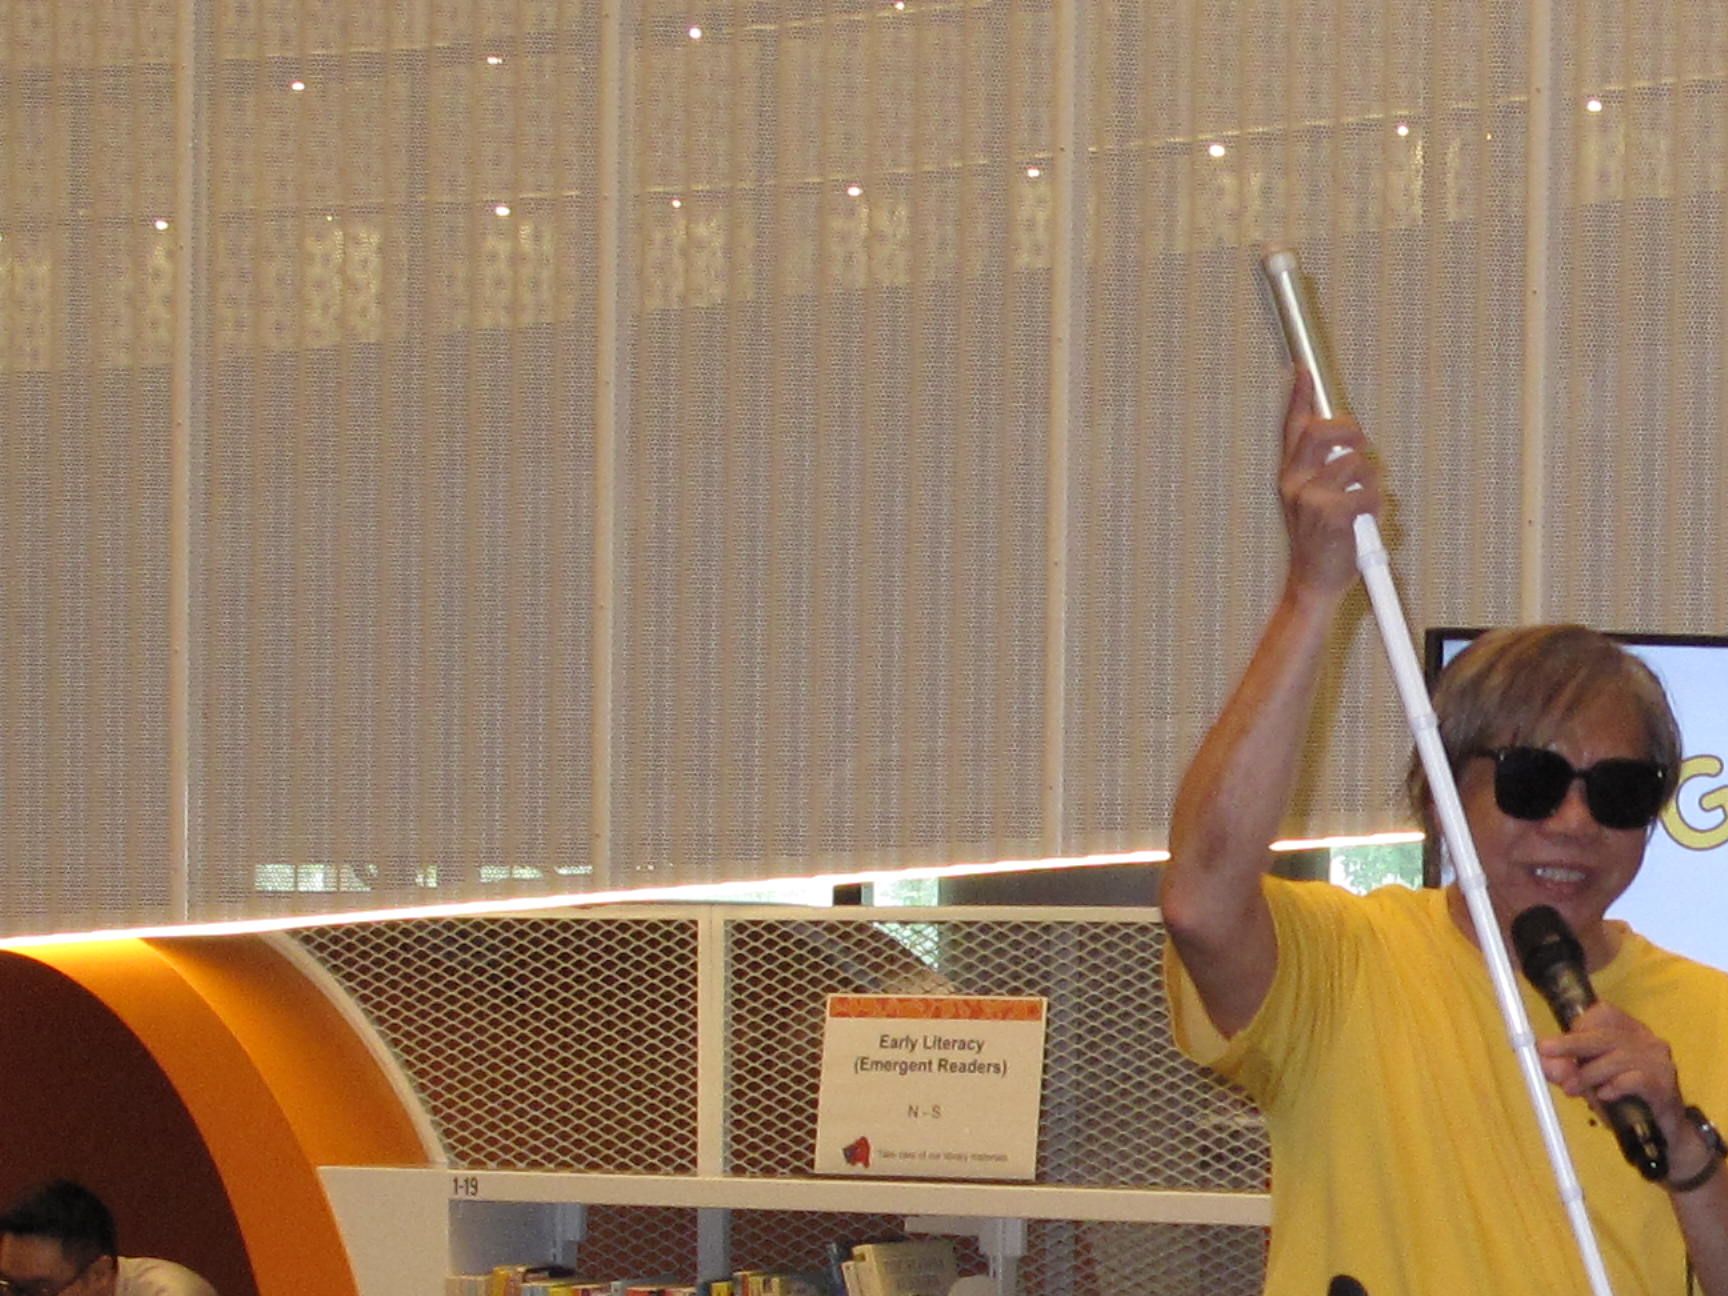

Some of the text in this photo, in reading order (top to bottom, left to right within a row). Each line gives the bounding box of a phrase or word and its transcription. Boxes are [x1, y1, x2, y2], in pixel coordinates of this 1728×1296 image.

[878, 1034, 985, 1055] Early Literacy
[854, 1056, 1008, 1078] (Emergent Readers)
[907, 1104, 919, 1119] N
[931, 1104, 941, 1120] S
[453, 1175, 479, 1197] 1-19
